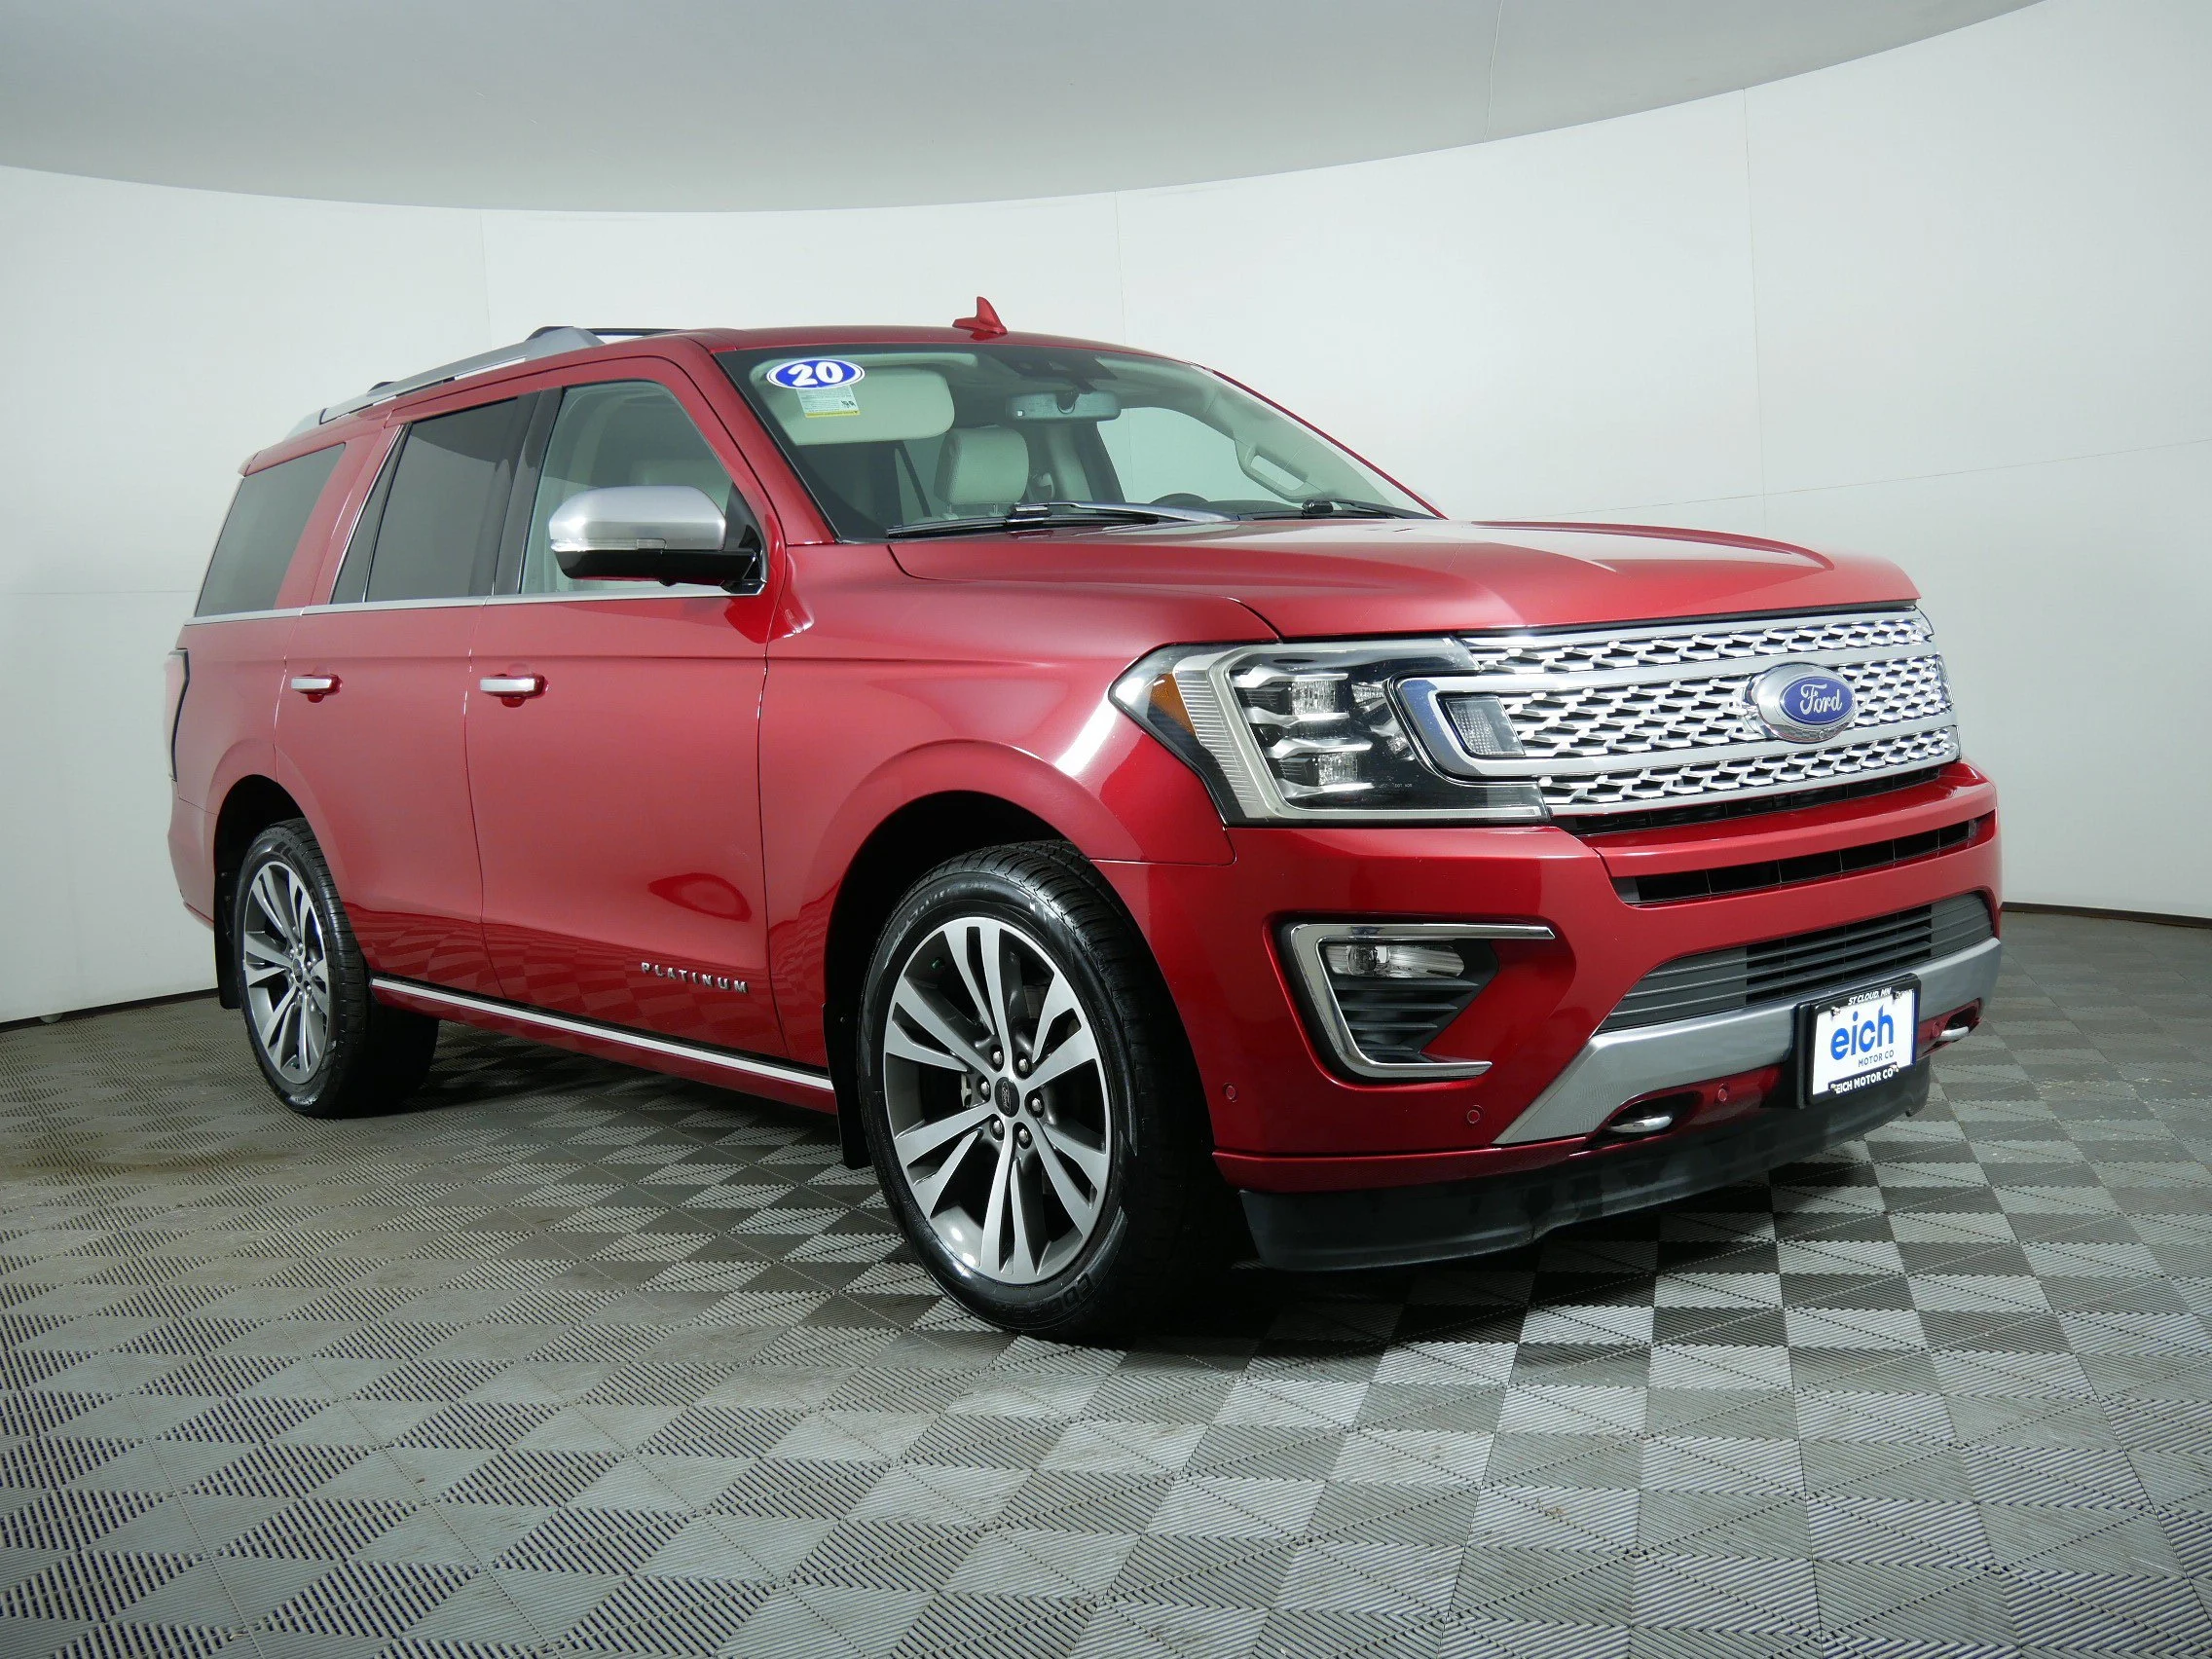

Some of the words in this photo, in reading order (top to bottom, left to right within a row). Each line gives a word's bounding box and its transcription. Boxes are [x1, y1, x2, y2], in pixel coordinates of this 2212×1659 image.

[787, 361, 844, 387] 20
[1799, 682, 1843, 716] Ford
[641, 961, 749, 994] PLATINUM
[1880, 986, 1892, 998] MN
[1830, 1005, 1895, 1061] eich
[1858, 1052, 1883, 1068] MOTOR
[1884, 1050, 1895, 1059] CO
[1854, 1071, 1882, 1088] MOTOR
[1882, 1067, 1894, 1080] CO
